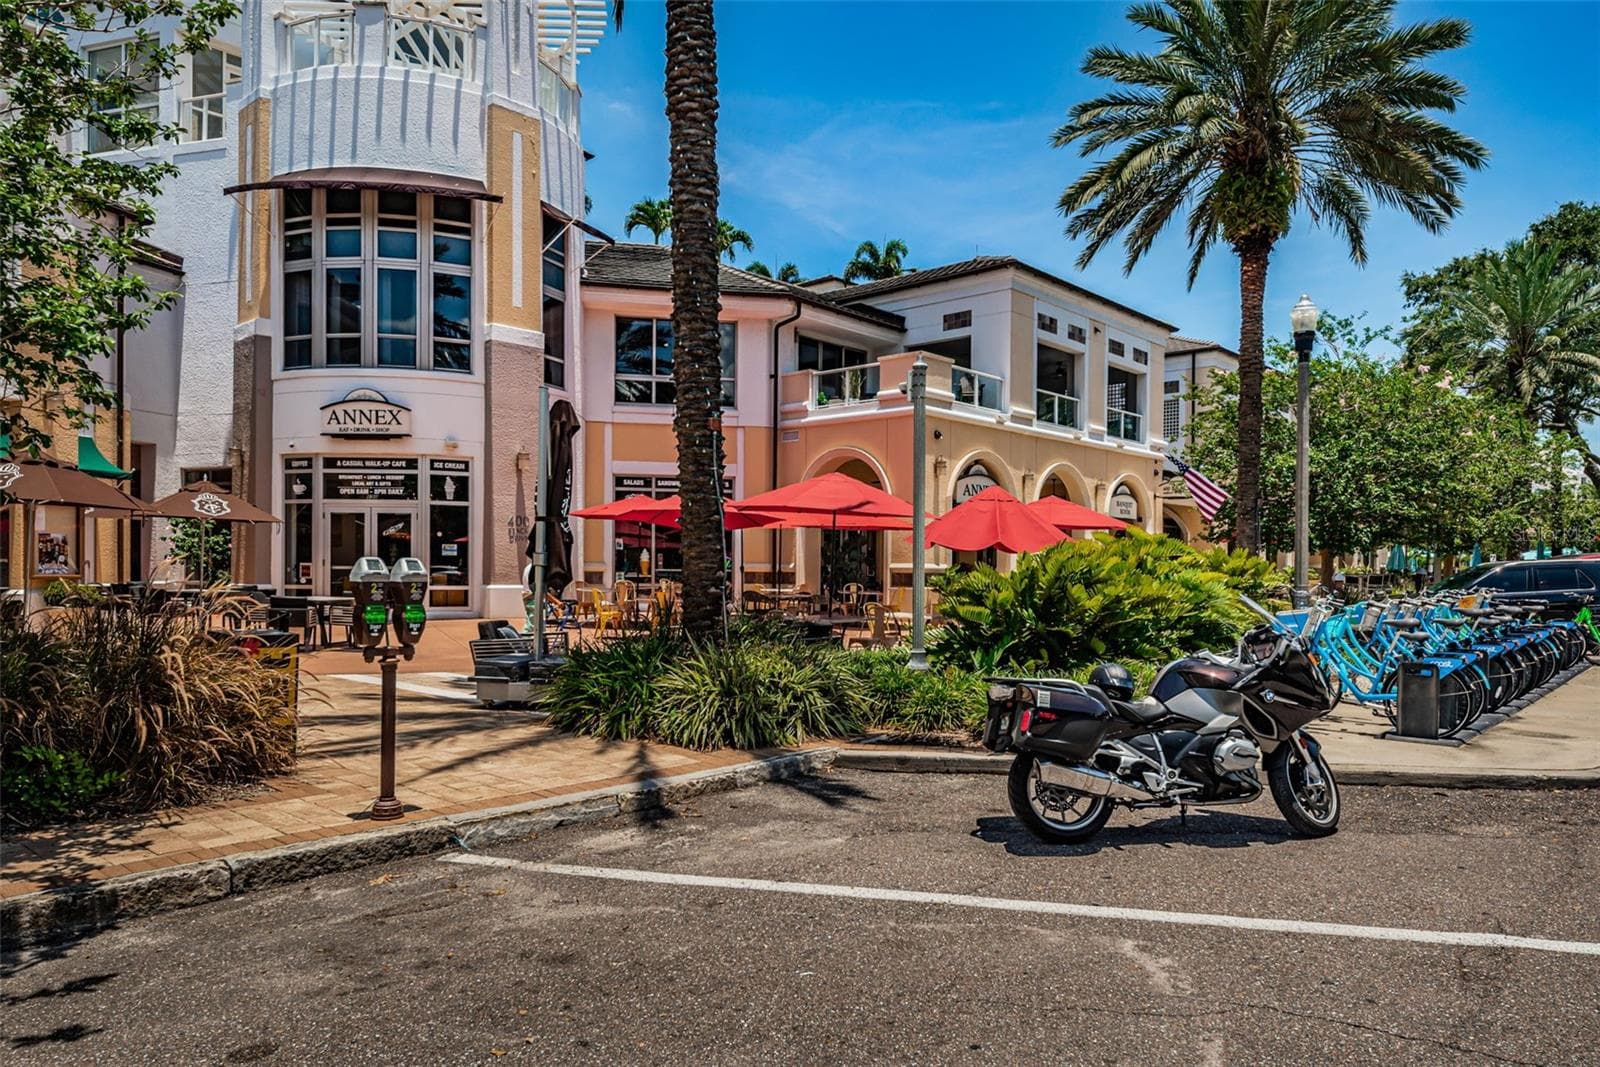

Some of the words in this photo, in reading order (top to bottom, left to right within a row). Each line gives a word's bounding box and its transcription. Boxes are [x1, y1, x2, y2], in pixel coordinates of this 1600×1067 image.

[327, 409, 402, 425] ANNEX
[507, 515, 530, 527] 400
[370, 583, 378, 593] 2
[410, 583, 417, 593] 2
